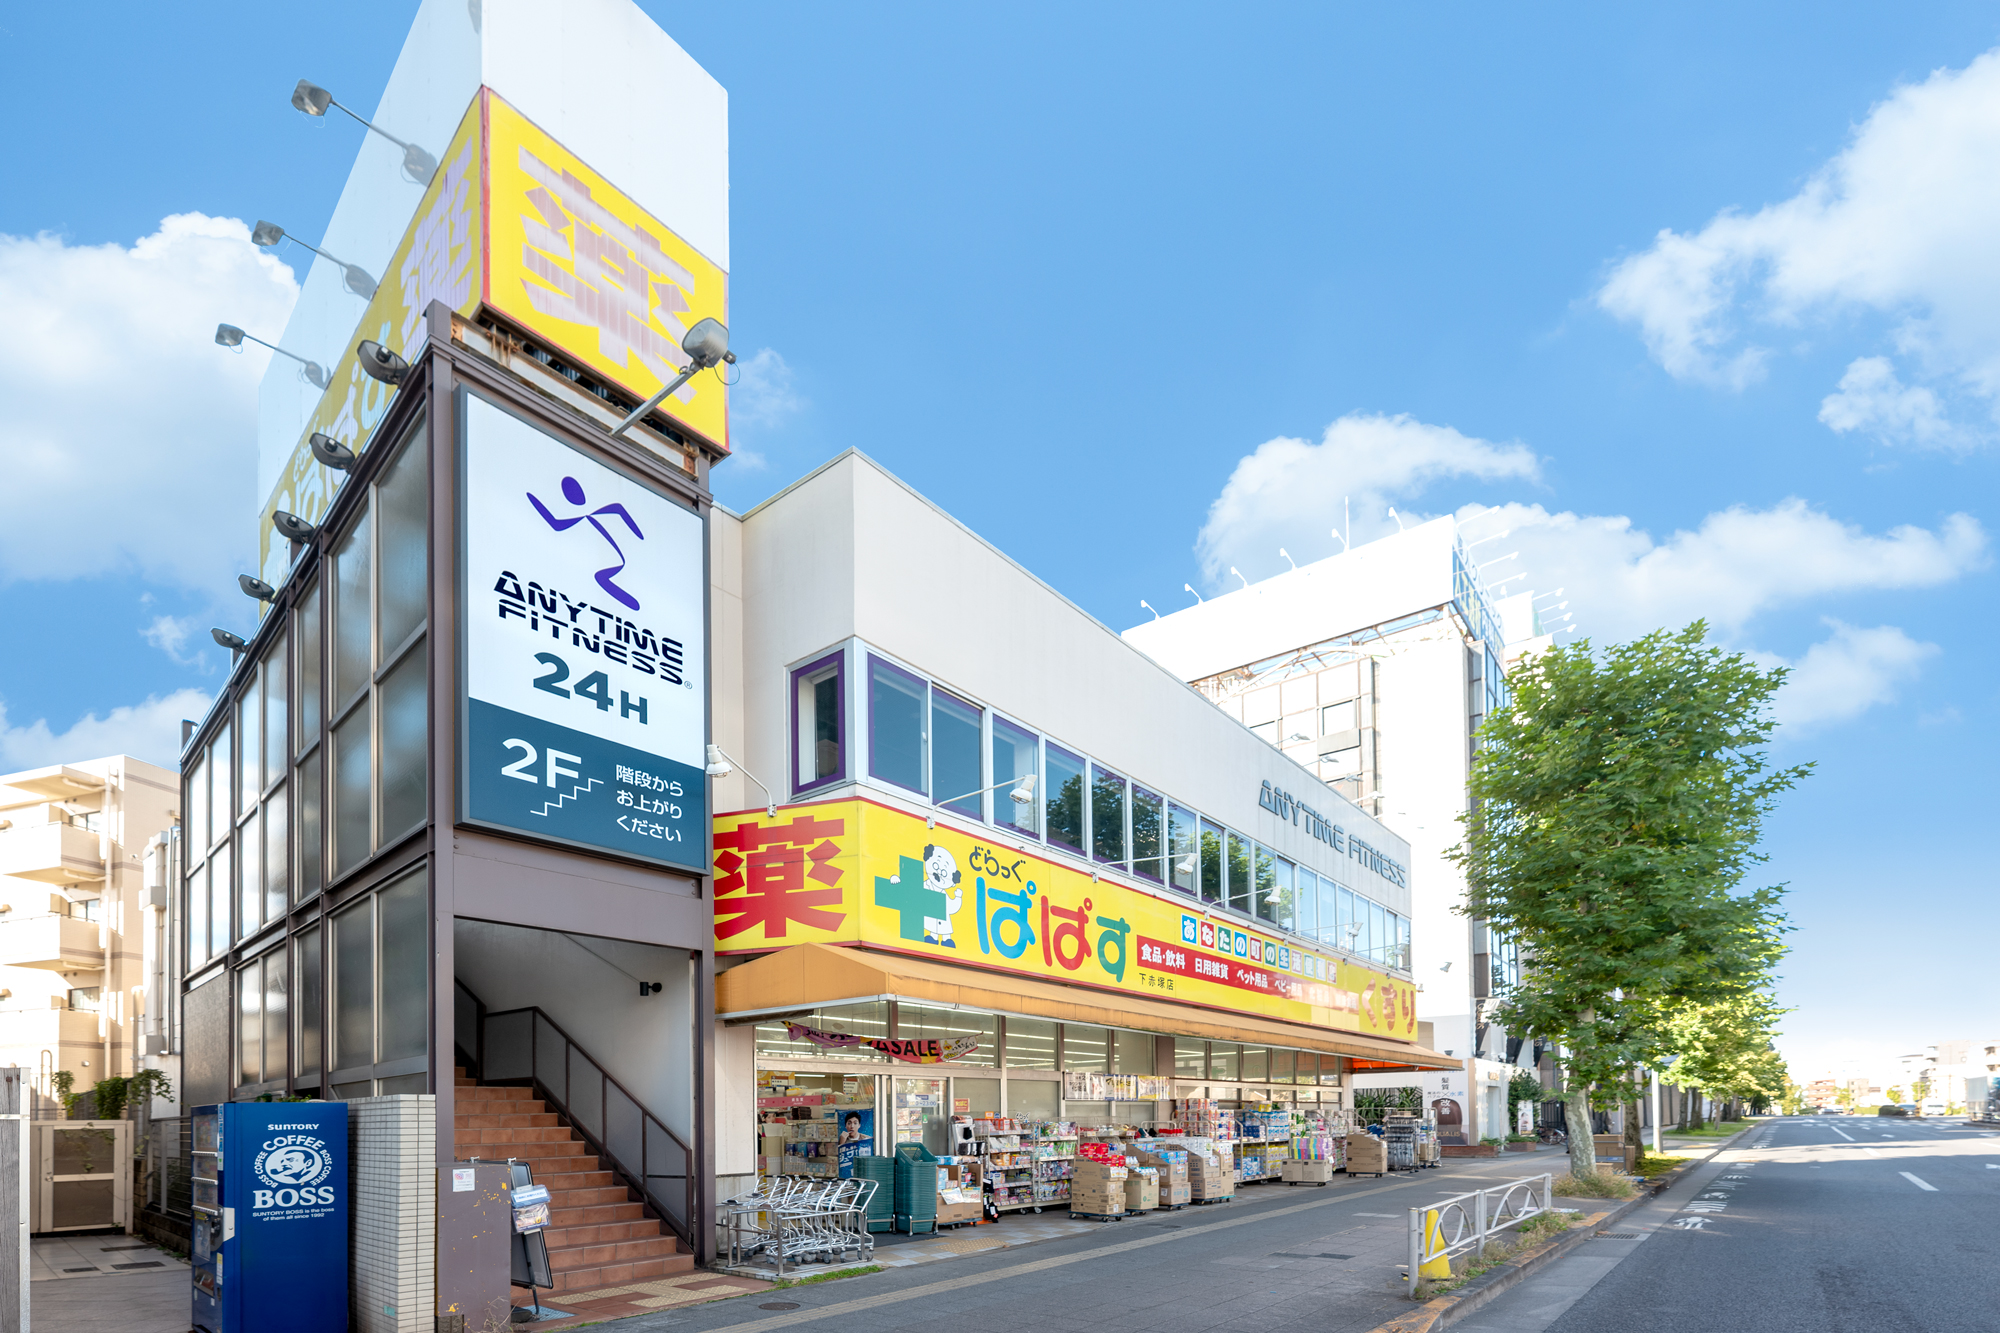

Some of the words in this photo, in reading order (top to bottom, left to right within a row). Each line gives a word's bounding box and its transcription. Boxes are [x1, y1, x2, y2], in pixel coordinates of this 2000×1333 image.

[494, 570, 683, 666] ANYTIME
[498, 598, 683, 686] FITNESS
[533, 652, 648, 725] 24H
[501, 738, 582, 789] 2F
[616, 764, 684, 797] 階段から
[616, 789, 683, 820] お上がり
[616, 815, 682, 842] ください
[1258, 779, 1345, 854] ANYTIME
[1348, 833, 1406, 889] FITNESS
[713, 815, 846, 941] 薬
[969, 845, 1027, 884] どらっぐ
[976, 876, 1131, 983] ぱぱす
[1139, 972, 1174, 991] 下赤塚店
[1194, 957, 1229, 980] 日用雑貨
[1236, 968, 1268, 989] ペット用品
[1361, 977, 1415, 1035] くすり
[267, 1123, 319, 1131] SUNTORY
[262, 1135, 325, 1151] COFFEE
[319, 1149, 333, 1165] BOSS
[254, 1151, 268, 1175] COFFEE
[309, 1165, 332, 1186] COFFEE
[258, 1174, 279, 1188] BOSS
[252, 1186, 335, 1209] BOSS
[252, 1210, 285, 1218] SUNTORY
